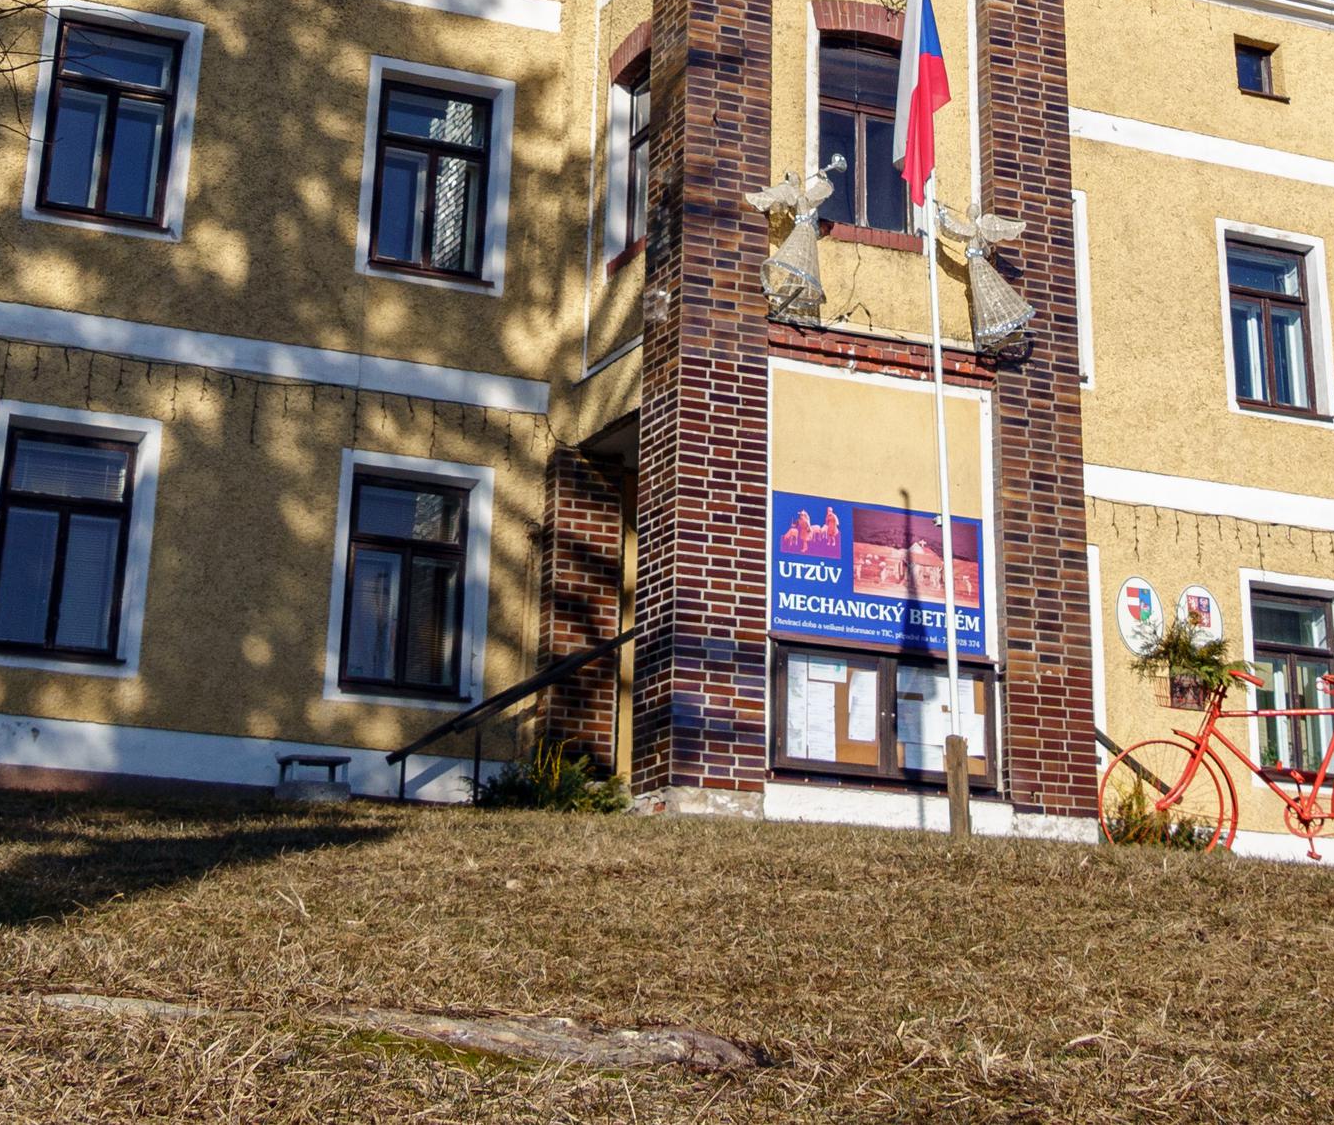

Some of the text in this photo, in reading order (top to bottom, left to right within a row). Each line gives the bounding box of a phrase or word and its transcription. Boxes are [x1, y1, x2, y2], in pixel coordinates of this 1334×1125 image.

[779, 561, 842, 583] UTZŮV
[779, 592, 980, 632] MECHANICKÝ BETÉM
